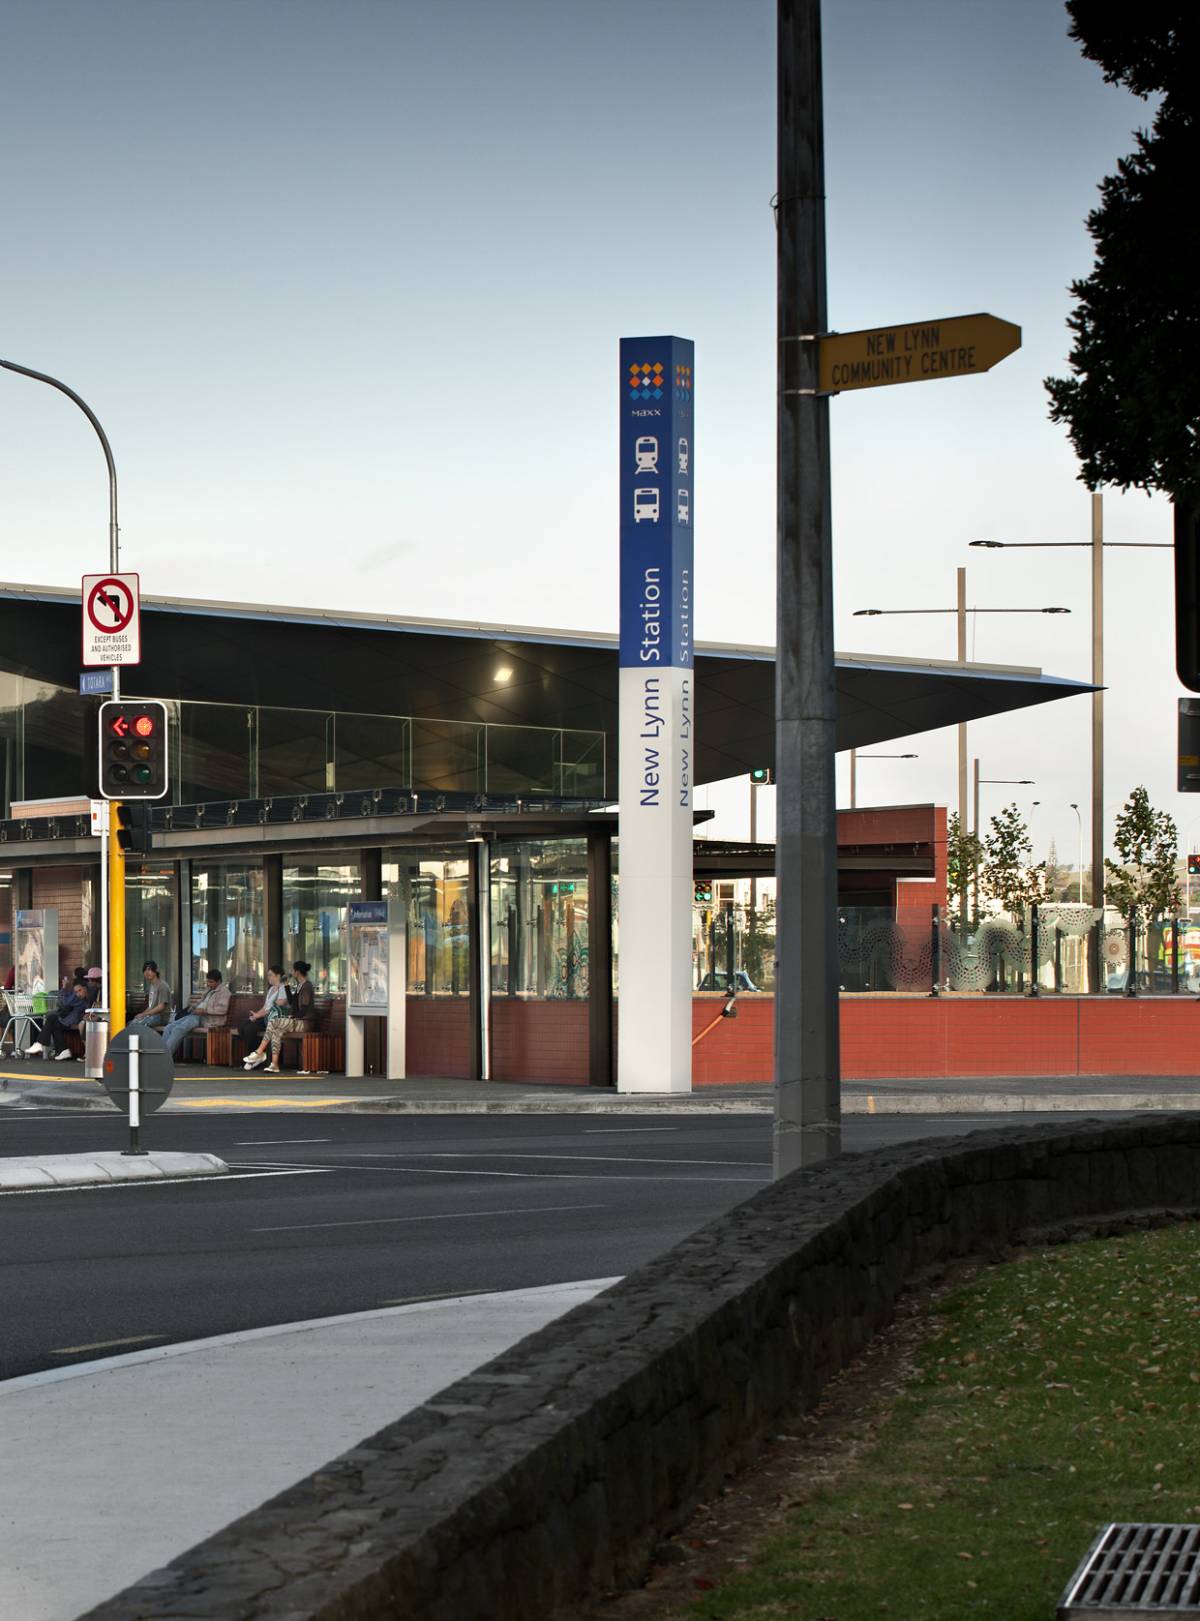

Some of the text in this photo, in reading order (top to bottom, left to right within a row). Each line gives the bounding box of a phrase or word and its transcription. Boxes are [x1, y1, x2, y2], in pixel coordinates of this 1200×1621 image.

[832, 346, 976, 385] COMMUNITY CENTRE
[867, 327, 940, 357] NEW LYNN
[94, 635, 128, 643] EXCEPT BUSES
[640, 567, 660, 661] Station
[680, 569, 689, 662] Station
[640, 678, 665, 807] New Lynn
[680, 679, 691, 807] New Lynn
